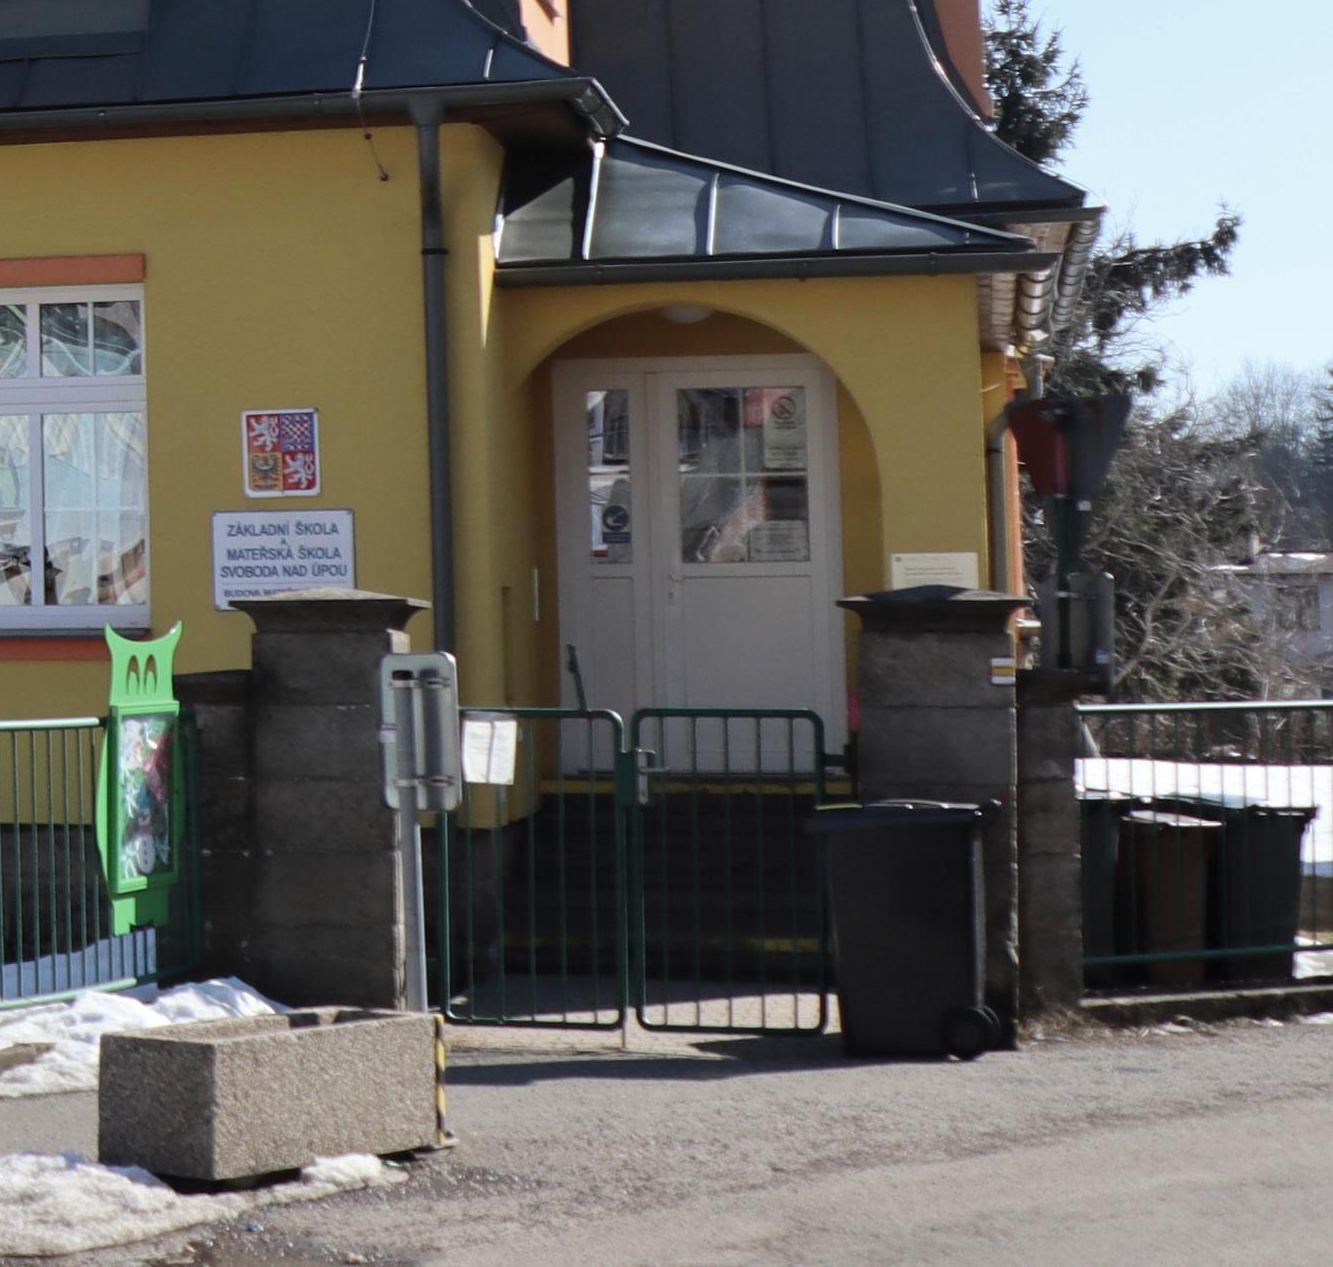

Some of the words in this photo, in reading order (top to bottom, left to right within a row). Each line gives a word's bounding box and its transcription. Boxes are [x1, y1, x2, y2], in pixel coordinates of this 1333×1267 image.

[227, 522, 290, 537] ZÁKLADNÍ
[295, 521, 340, 536] ŠKOLA
[226, 546, 294, 561] MATEŘSKÁ
[298, 545, 341, 560] ŠKOLA
[221, 566, 278, 578] SVOBODA
[282, 565, 308, 577] NAD
[311, 562, 348, 577] ÚPOU
